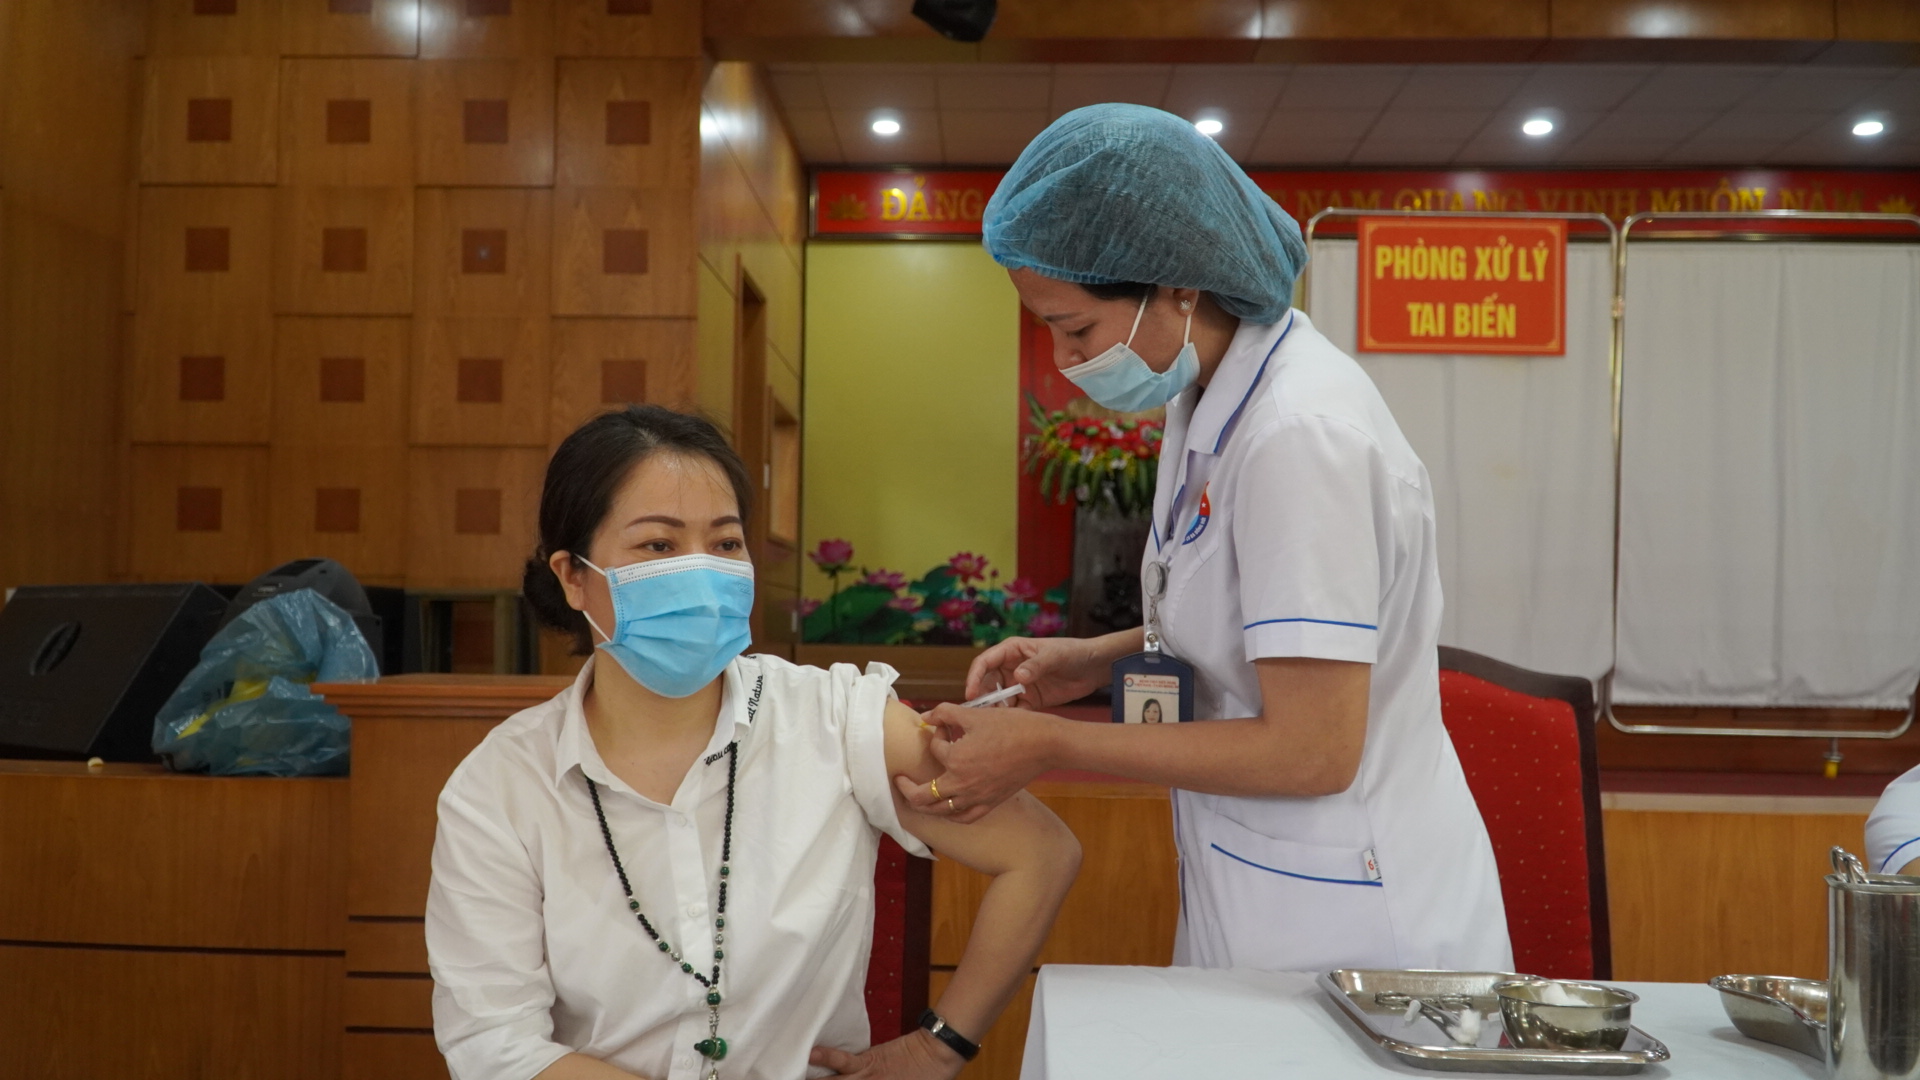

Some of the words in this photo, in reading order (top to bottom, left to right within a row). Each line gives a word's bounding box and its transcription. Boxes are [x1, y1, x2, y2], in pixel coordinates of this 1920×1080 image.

[880, 175, 984, 221] ĐẢNG
[1296, 188, 1382, 221] NAM
[1538, 188, 1638, 220] VINH
[1375, 237, 1467, 280] PHÒNG
[1474, 235, 1514, 281] XỬ
[1518, 240, 1549, 281] LÝ
[1407, 302, 1446, 337] TAI
[1453, 292, 1516, 338] BIẾN
